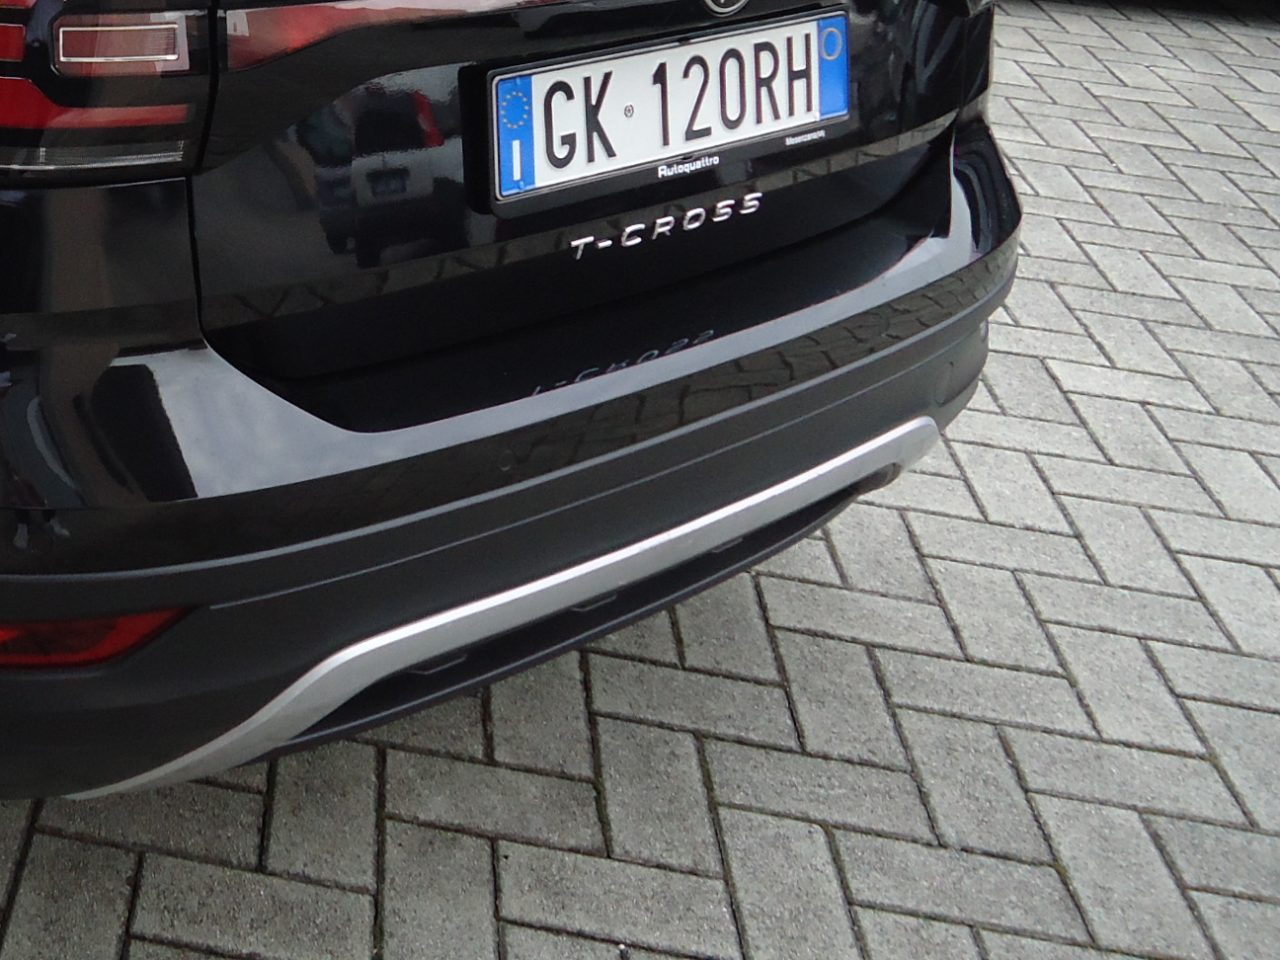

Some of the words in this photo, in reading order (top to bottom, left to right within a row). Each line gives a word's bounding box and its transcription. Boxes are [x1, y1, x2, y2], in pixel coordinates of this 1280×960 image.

[543, 70, 617, 170] GK
[652, 32, 814, 147] 120RH
[657, 155, 720, 179] Autoquattro
[570, 191, 763, 261] T-CROSS
